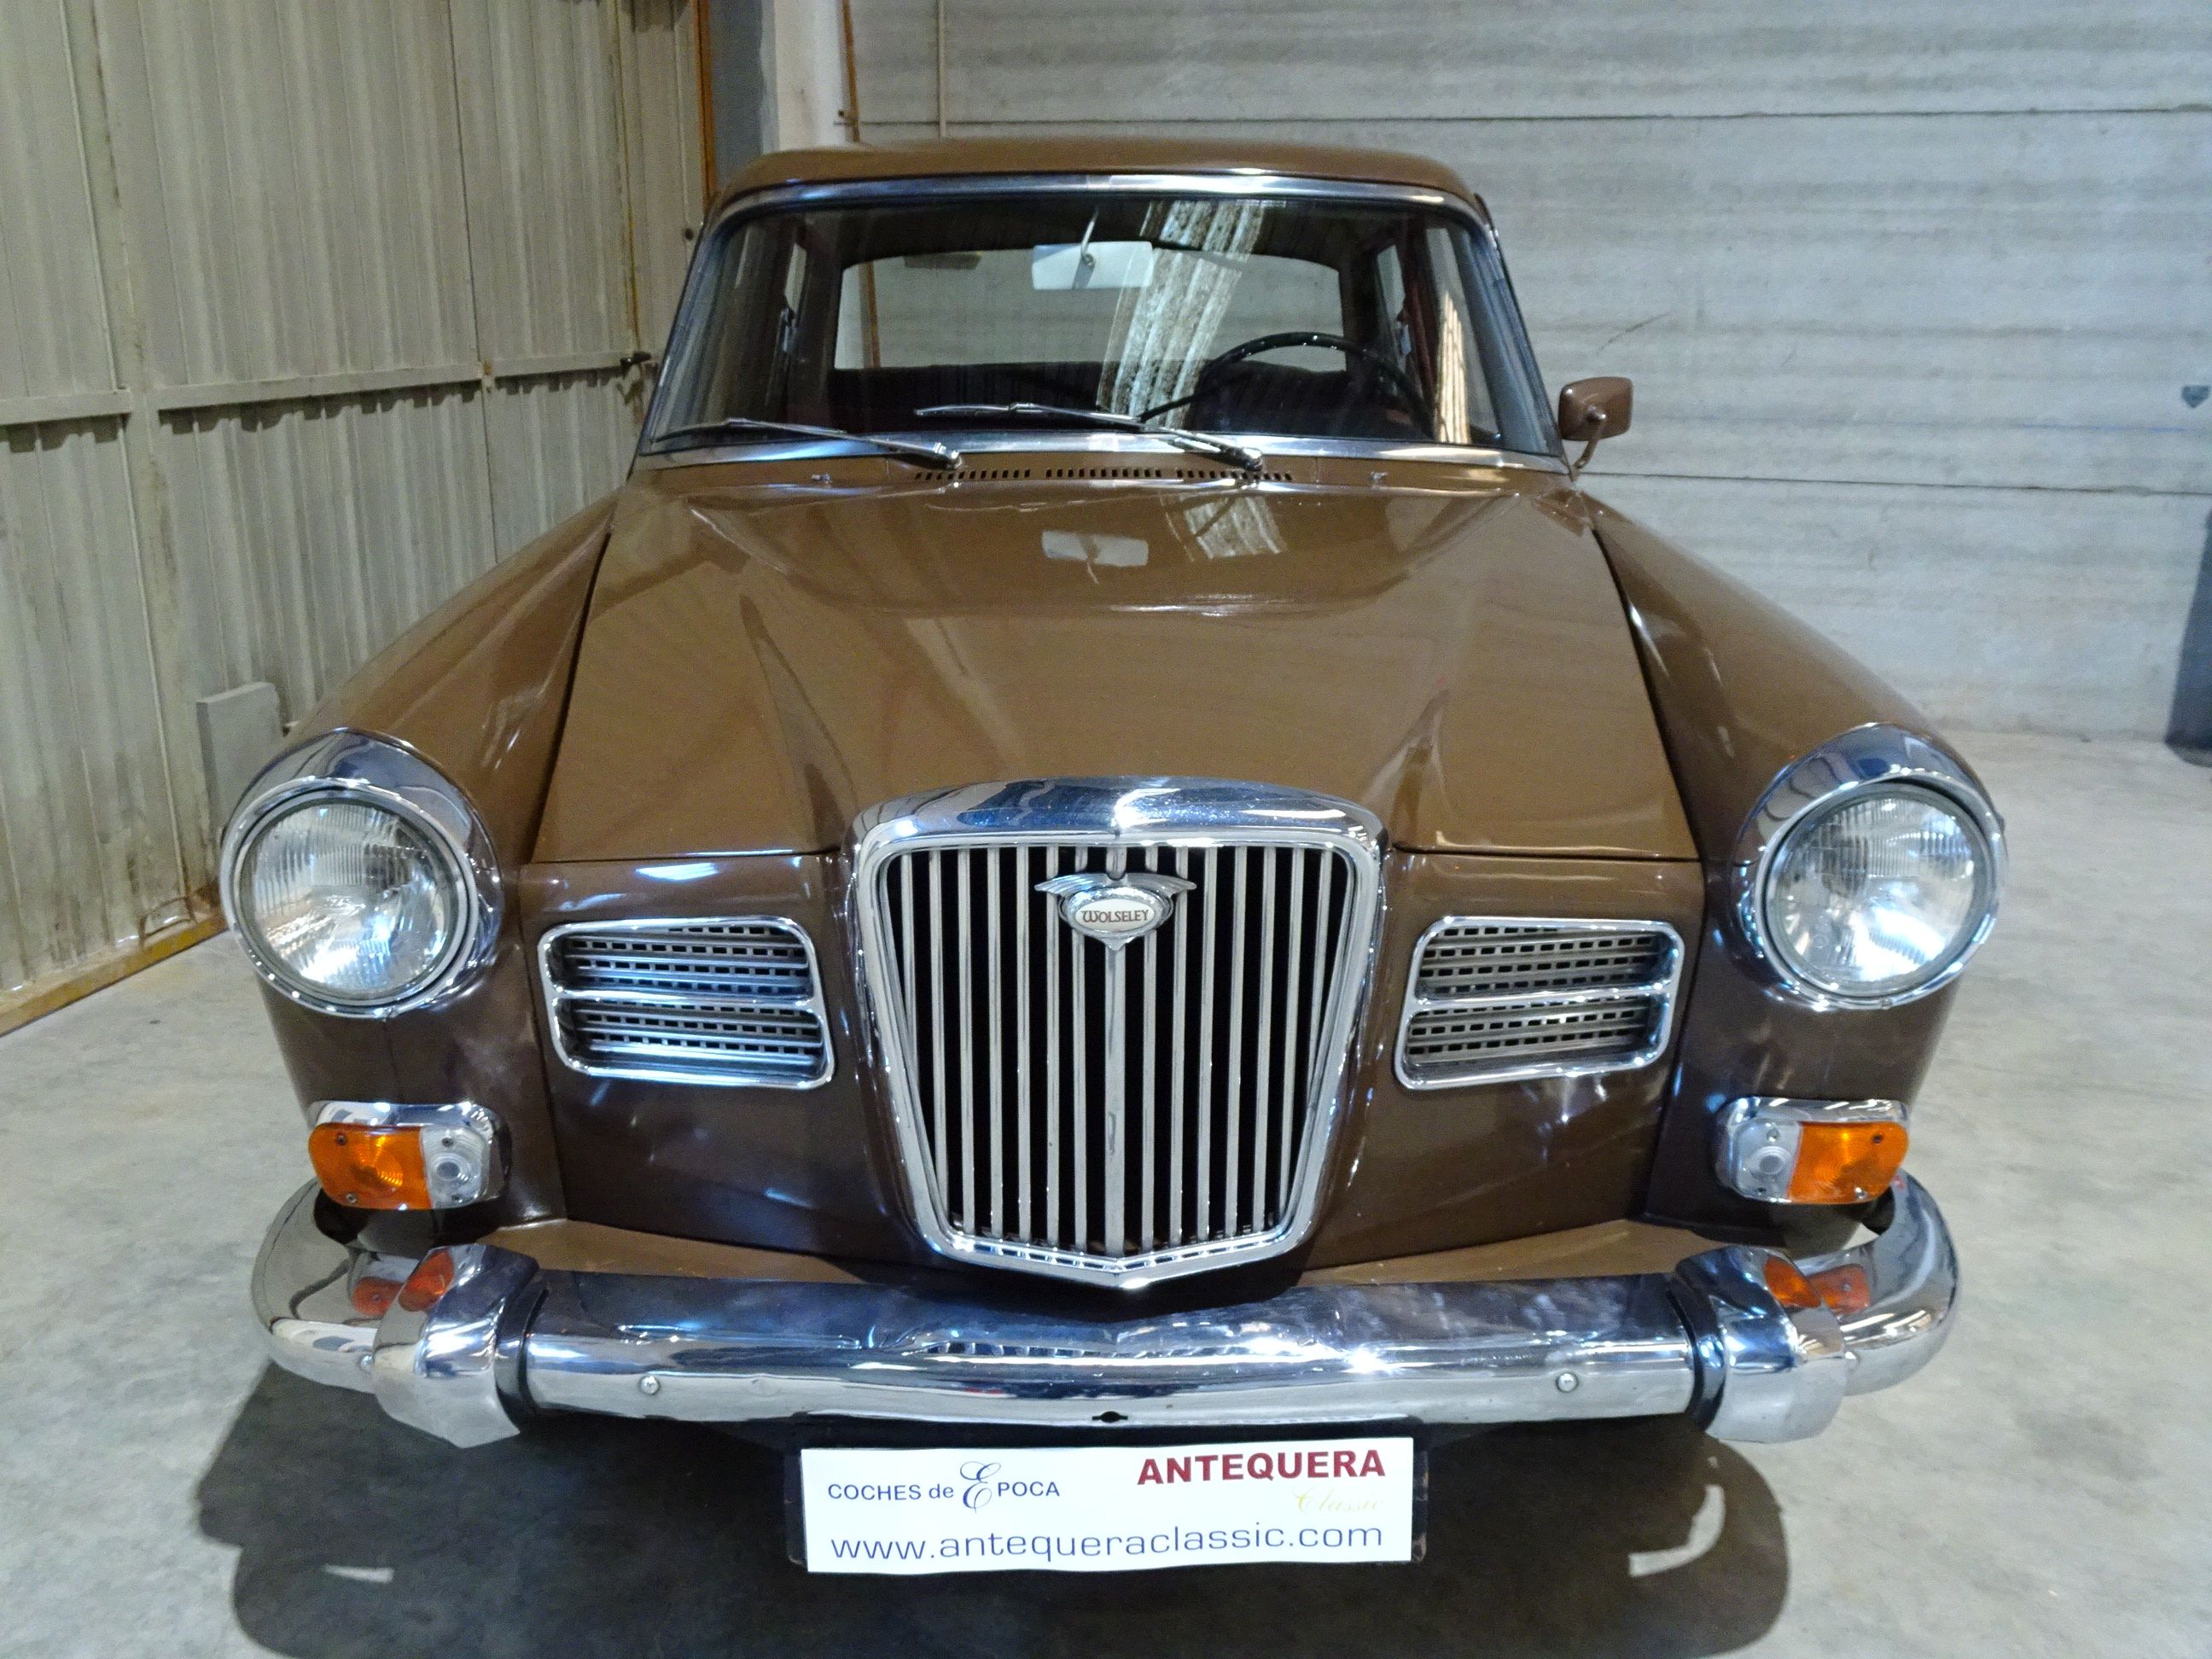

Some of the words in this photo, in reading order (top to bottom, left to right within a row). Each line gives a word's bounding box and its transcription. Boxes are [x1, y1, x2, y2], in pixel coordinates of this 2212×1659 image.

[1081, 909, 1150, 923] WOLSELEY
[1137, 1449, 1386, 1485] ANTEQUERA
[828, 1484, 922, 1500] COCHES
[928, 1483, 954, 1499] de
[1292, 1487, 1384, 1512] Classic
[830, 1522, 1382, 1563] www.antequeraclassic.com
